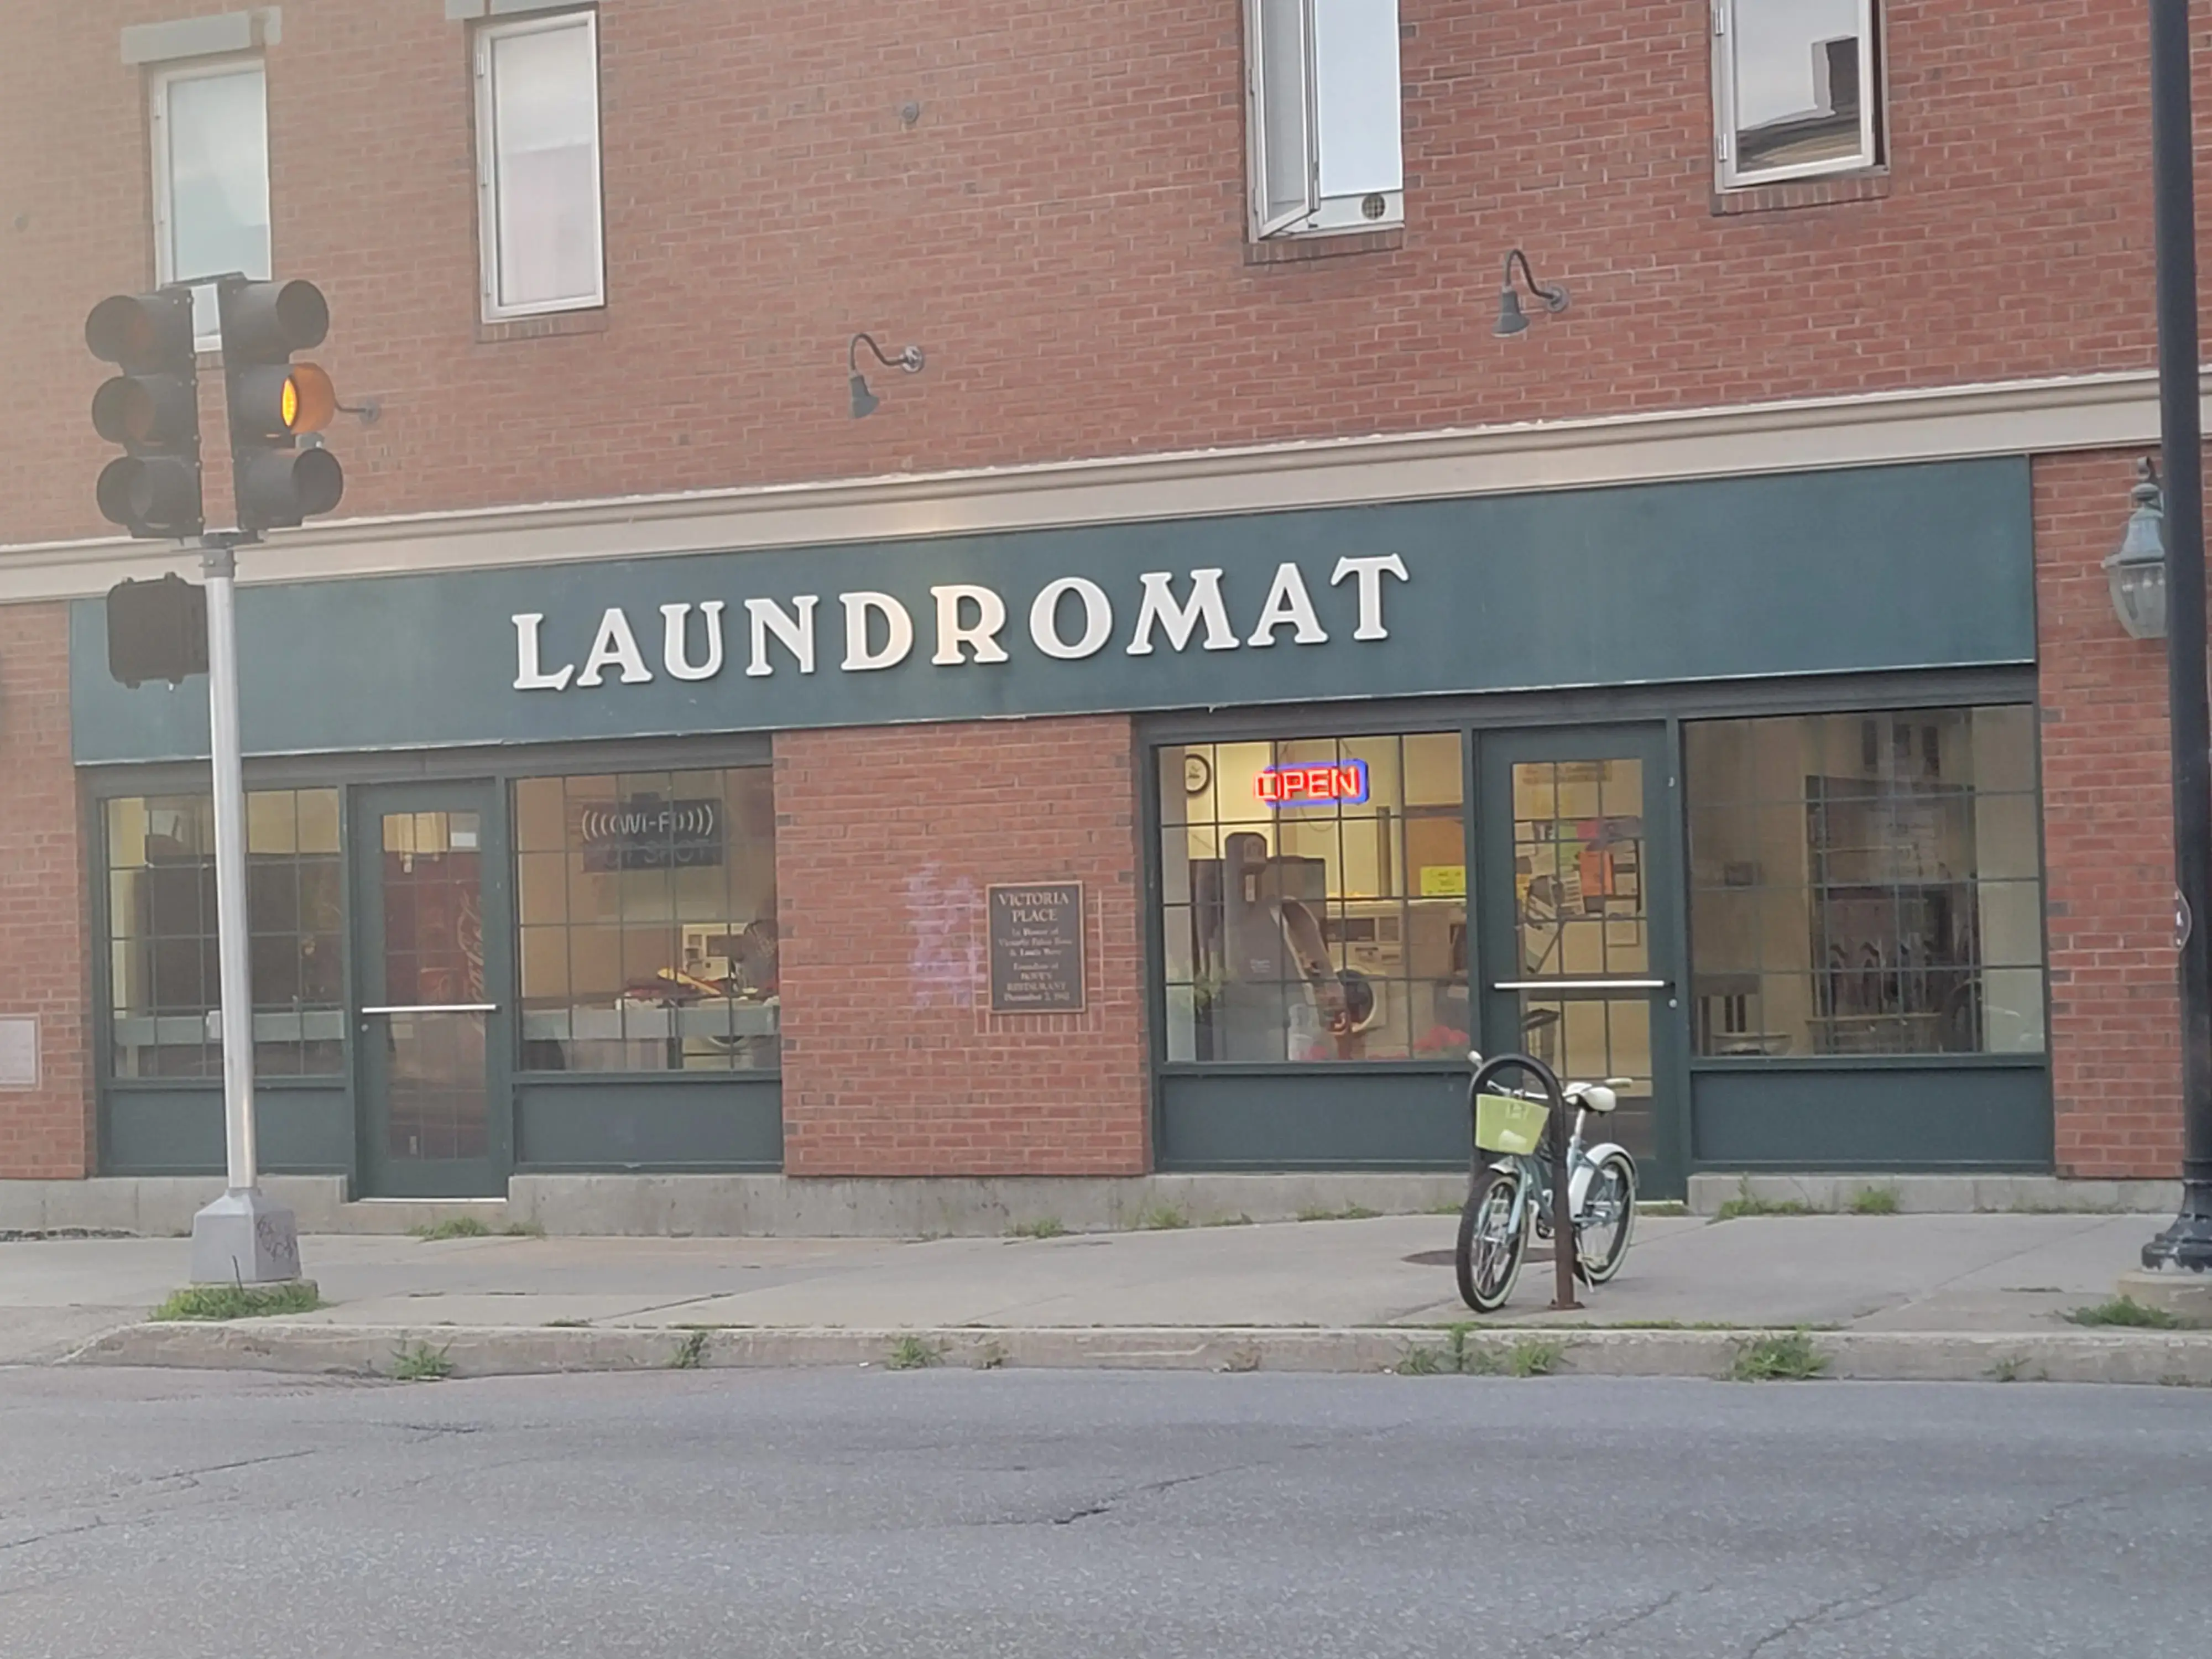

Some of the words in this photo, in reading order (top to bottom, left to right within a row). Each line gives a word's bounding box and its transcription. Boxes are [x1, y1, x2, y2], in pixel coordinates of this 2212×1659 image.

[512, 552, 1409, 691] LAUNDROMAT
[1254, 766, 1359, 801] OPEN
[998, 891, 1069, 907] VICTORIA
[1011, 909, 1058, 923] PLACE
